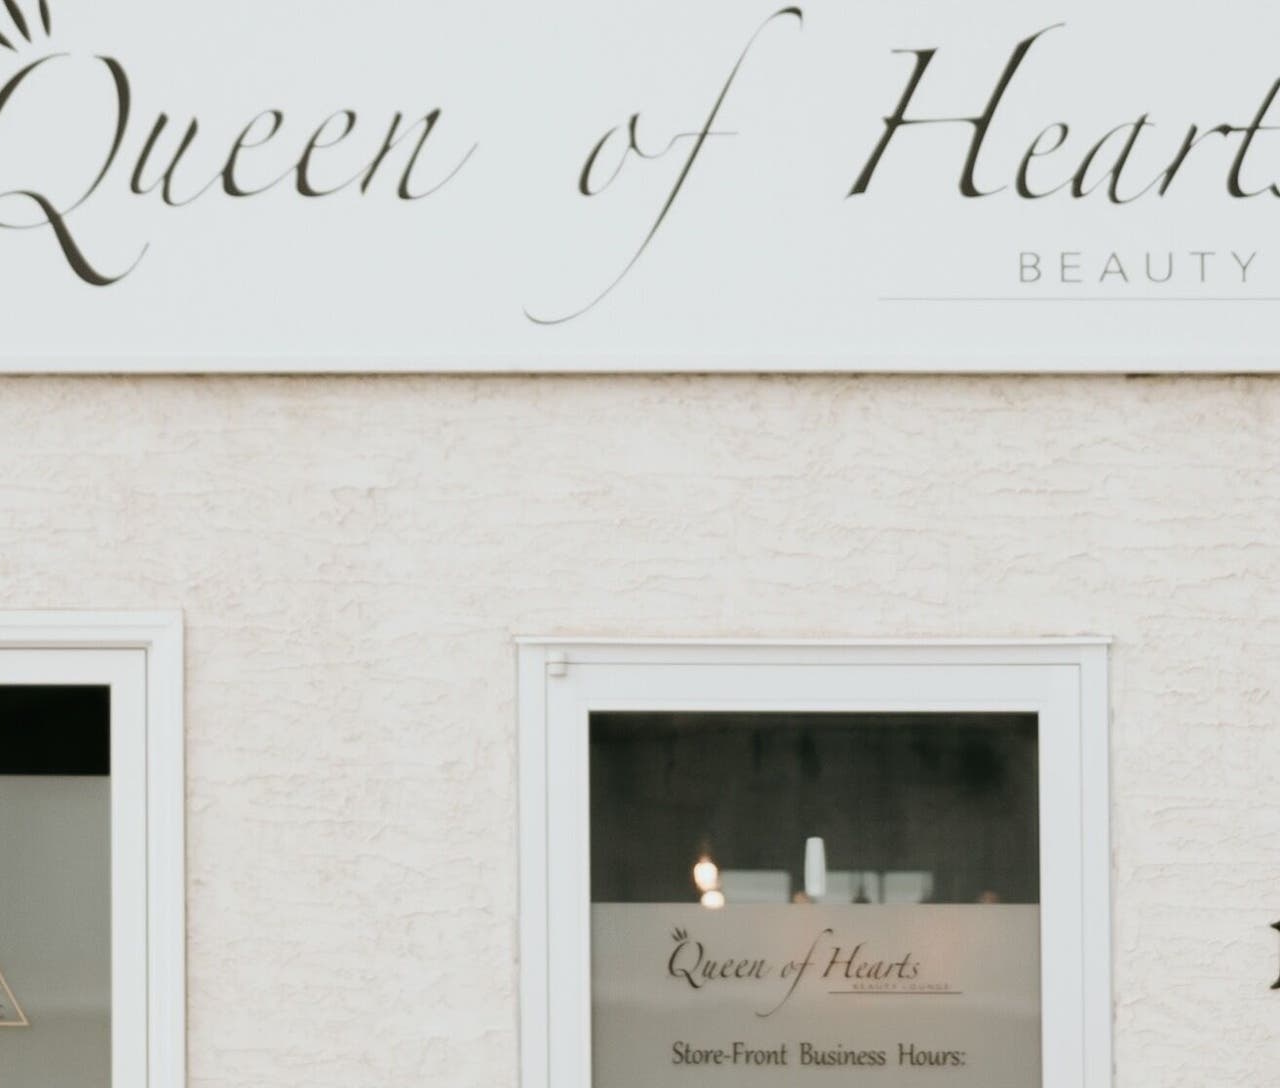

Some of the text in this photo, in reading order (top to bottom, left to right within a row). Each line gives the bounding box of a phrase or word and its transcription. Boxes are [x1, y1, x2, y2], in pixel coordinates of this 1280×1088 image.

[523, 6, 803, 325] of
[1018, 251, 1259, 284] BEAUTY
[668, 928, 920, 1018] Queen of Hearts
[671, 1041, 966, 1067] Store-Front Business Hours:
